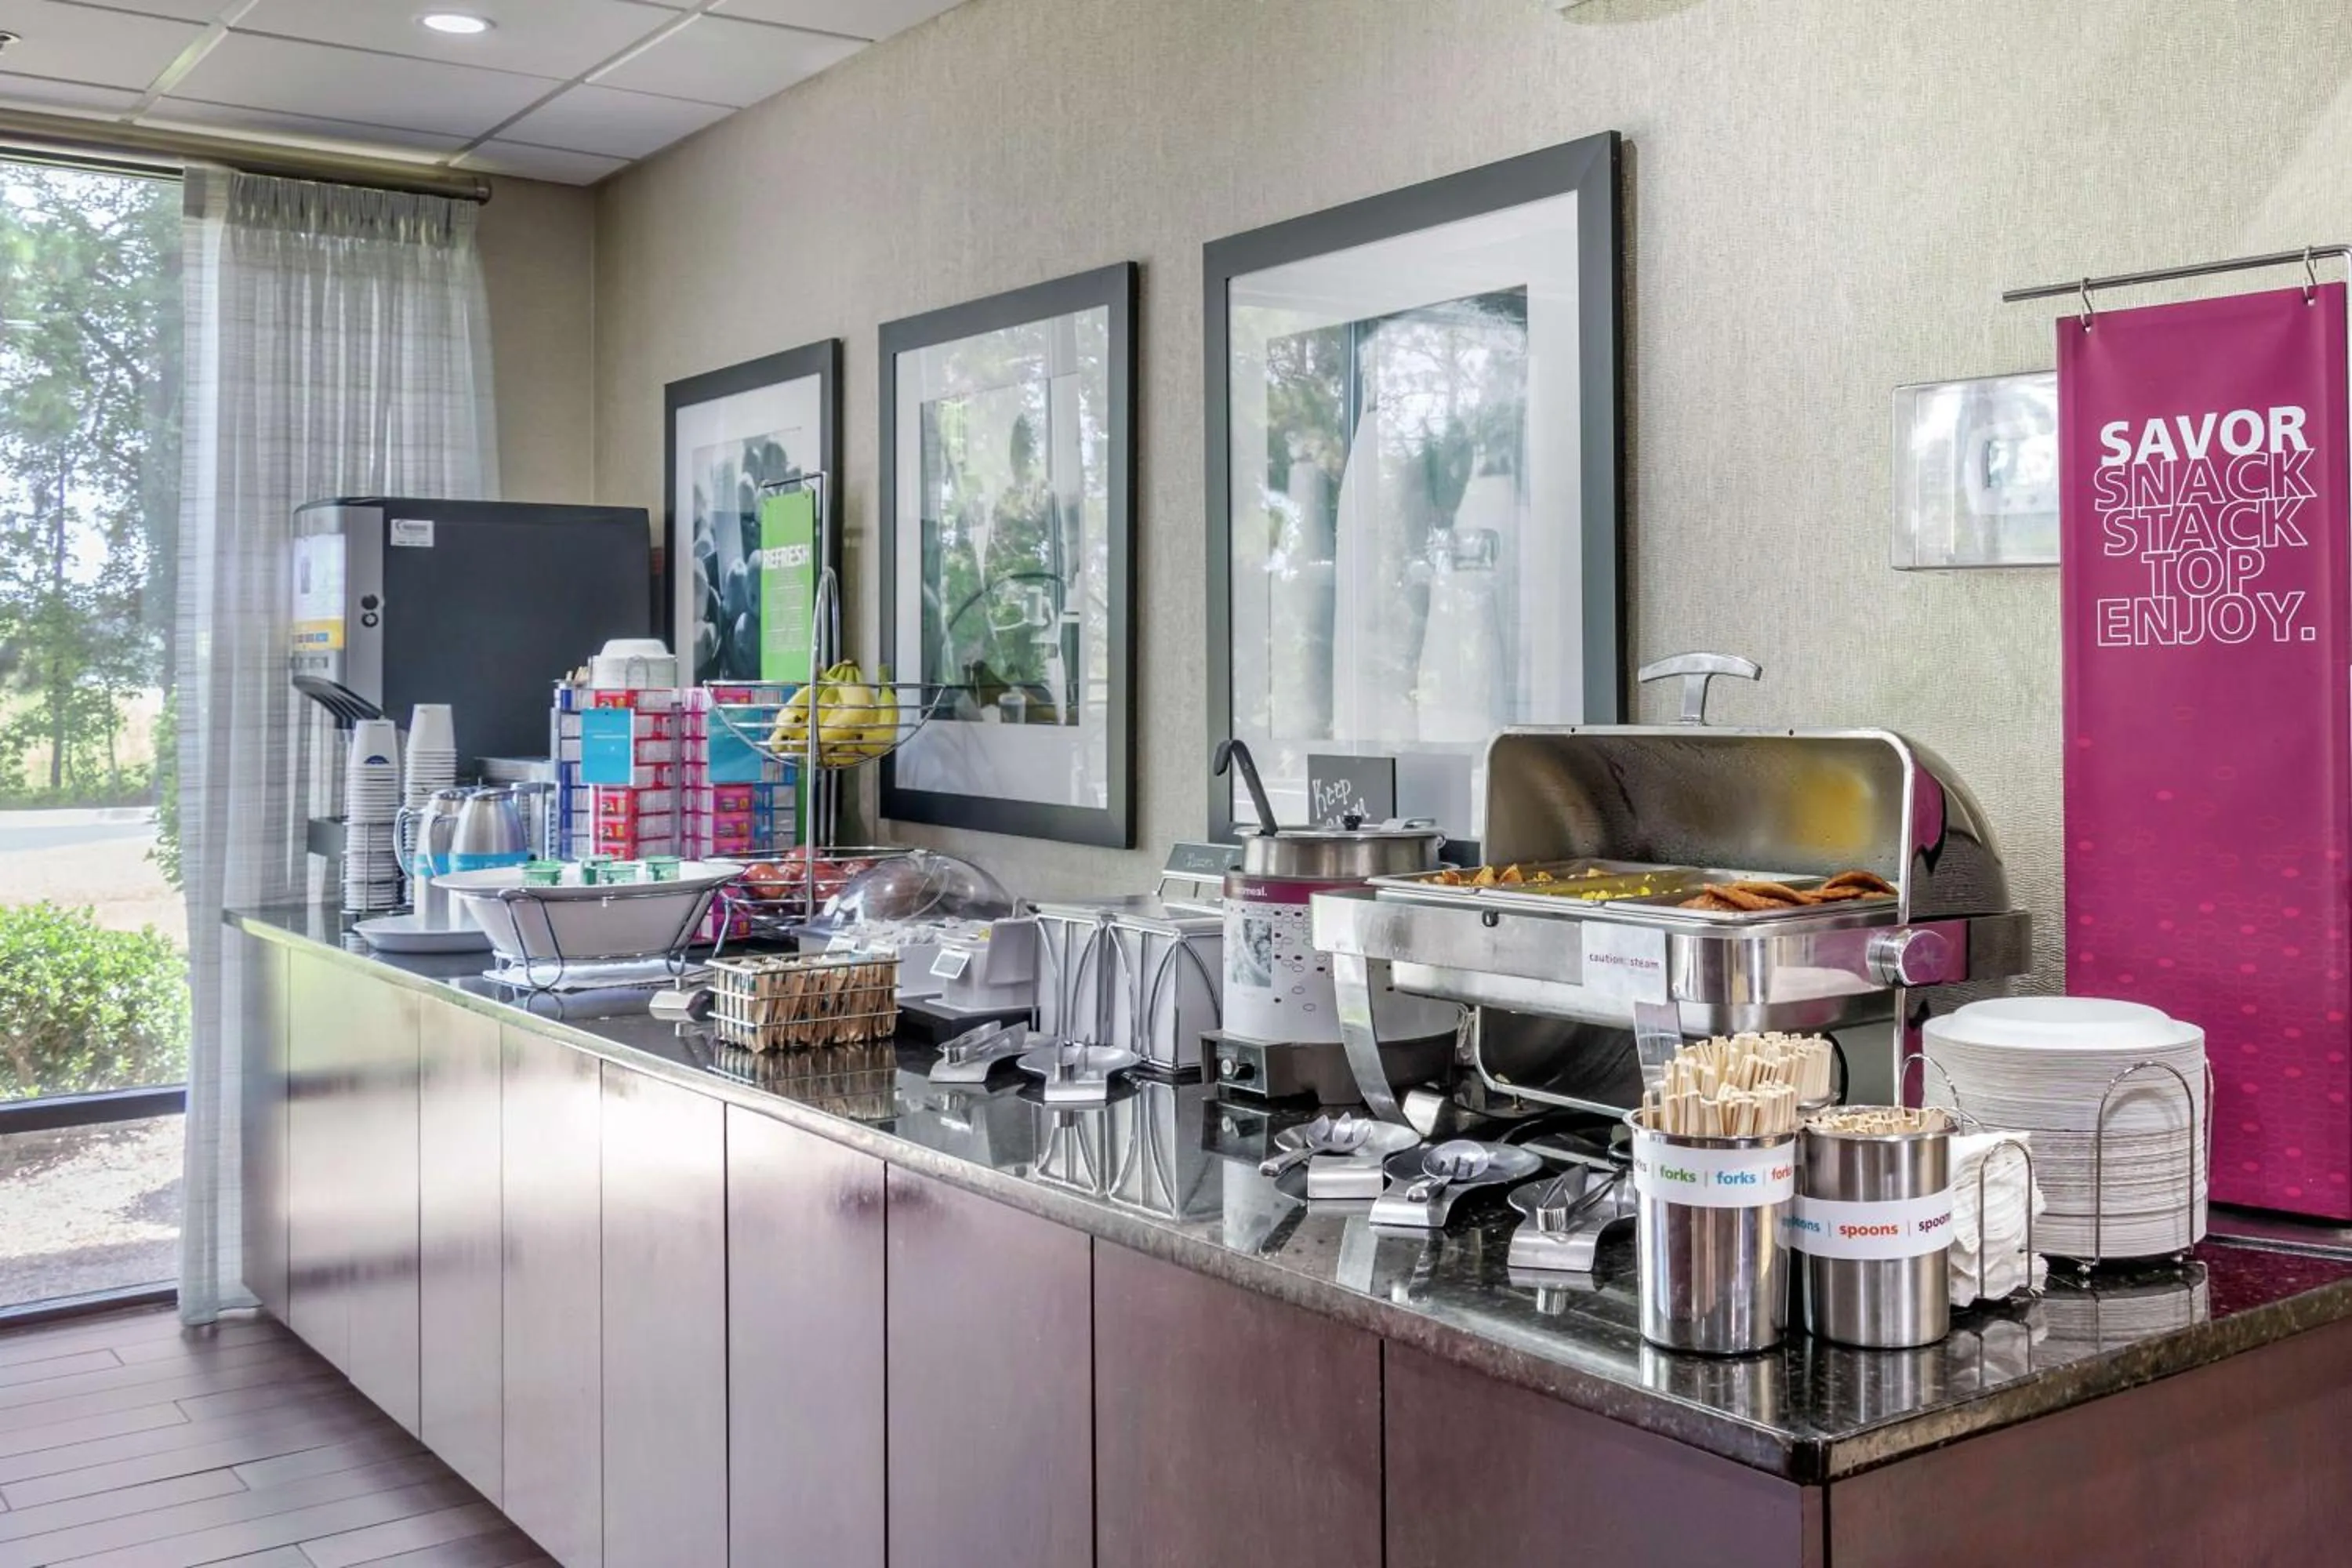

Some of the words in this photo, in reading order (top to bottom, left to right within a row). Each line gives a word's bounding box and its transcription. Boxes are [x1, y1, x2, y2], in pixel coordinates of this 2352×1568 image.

[2100, 405, 2308, 466] SAVOR
[2093, 448, 2318, 512] SNACK
[2103, 496, 2309, 557] STACK
[2140, 546, 2266, 600] TOP
[2096, 590, 2316, 647] ENJOY.
[1630, 957, 1659, 970] steam
[1660, 1164, 1697, 1183] forks
[1716, 1171, 1756, 1185] forks
[1838, 1225, 1899, 1239] spoons
[1918, 1211, 1951, 1233] spoon
